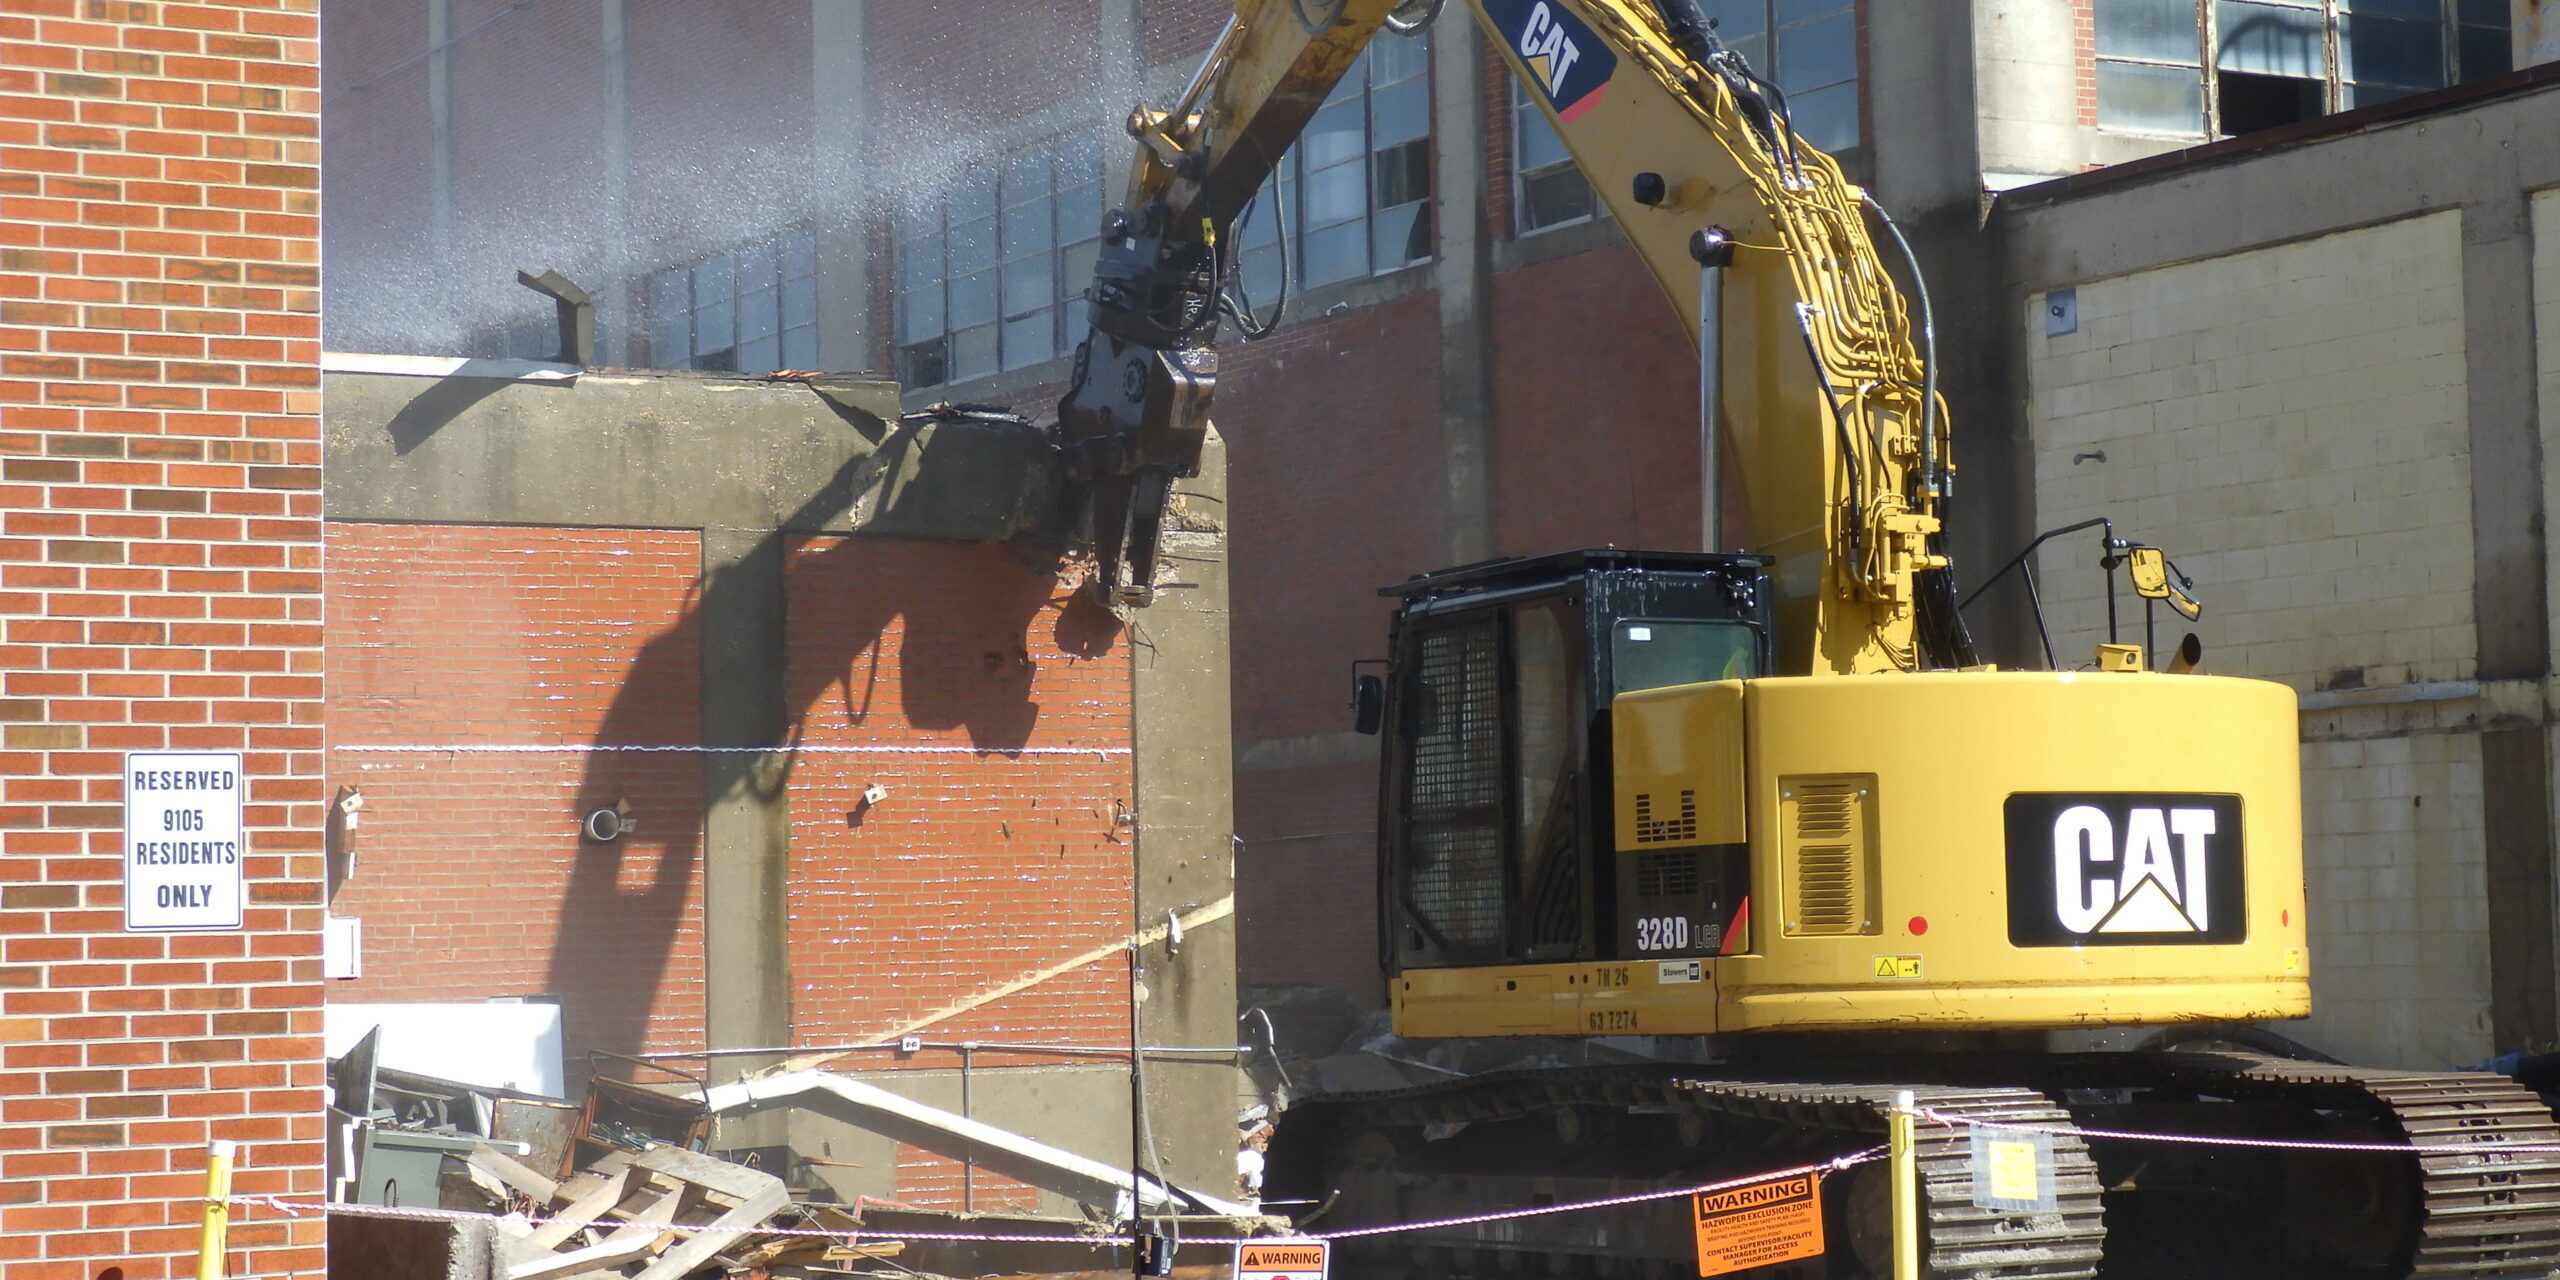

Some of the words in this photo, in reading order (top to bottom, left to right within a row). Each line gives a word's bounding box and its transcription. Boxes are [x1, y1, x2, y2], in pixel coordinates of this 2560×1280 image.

[1521, 1, 1580, 98] CAT
[135, 771, 234, 790] RESERVED
[164, 810, 204, 831] 9105
[137, 842, 236, 865] RESIDENTS
[2054, 805, 2216, 934] CAT
[157, 885, 212, 908] ONLY
[1637, 917, 1688, 951] 328D
[1694, 924, 1721, 949] LCR
[1597, 968, 1610, 986] TH
[1615, 967, 1629, 986] 26
[1663, 968, 1687, 977] Stowers
[1589, 1011, 1604, 1031] 63
[1608, 1010, 1638, 1030] 7274
[1705, 1181, 1805, 1211] WARNING
[1702, 1214, 1746, 1229] HAZWOPER
[1747, 1206, 1791, 1220] EXCLUSION
[1792, 1201, 1813, 1212] ZONE
[1707, 1246, 1738, 1257] CONTACT
[1739, 1231, 1813, 1251] SUPERVISOR/FACILITY
[1723, 1250, 1757, 1261] MANAGER
[1758, 1246, 1772, 1254] FOR
[1773, 1241, 1799, 1252] ACCESS
[1262, 1252, 1320, 1264] WARNING
[1733, 1250, 1789, 1266] AUTHORIZATION
